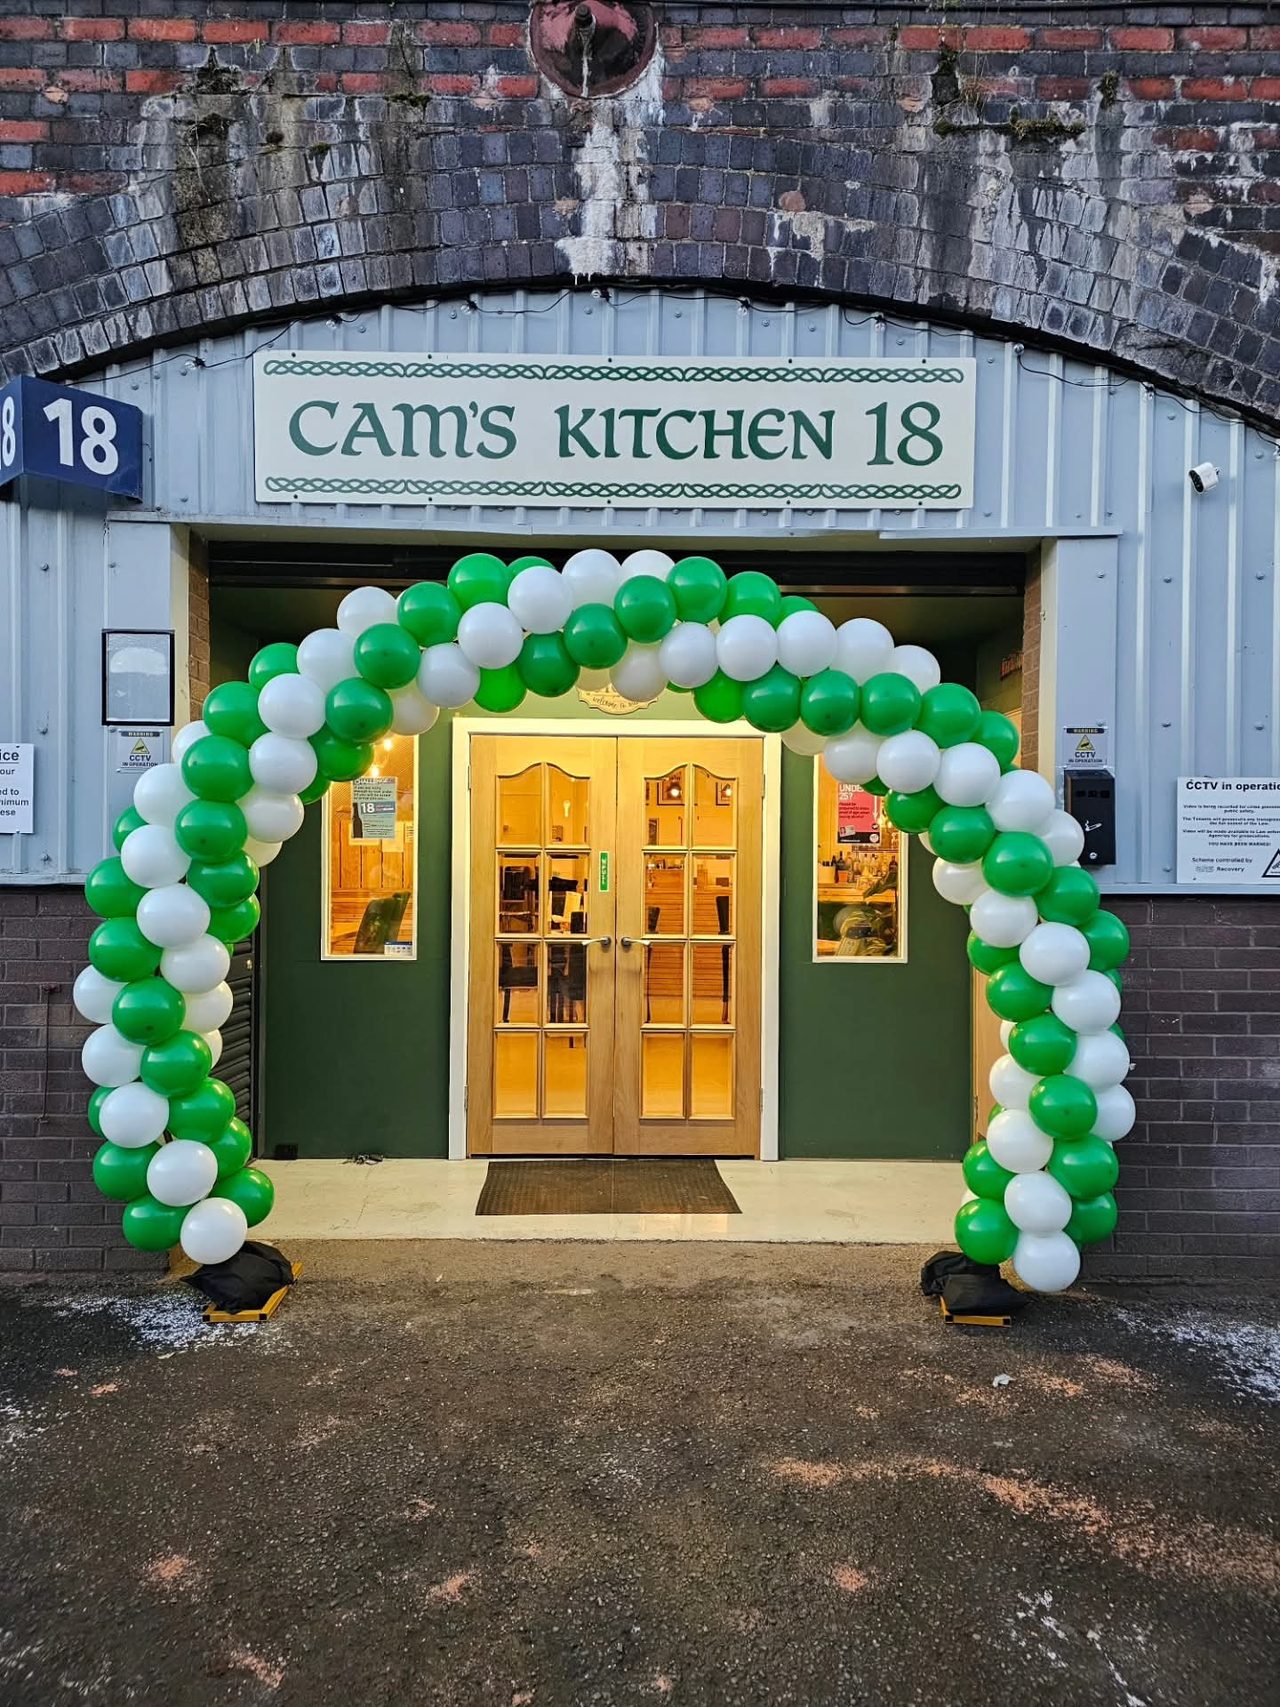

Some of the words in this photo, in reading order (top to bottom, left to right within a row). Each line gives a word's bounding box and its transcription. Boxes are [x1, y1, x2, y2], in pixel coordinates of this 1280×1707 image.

[0, 396, 16, 470] 8
[43, 398, 118, 475] 18
[289, 400, 517, 458] CAM'S
[556, 406, 835, 460] KITCHEN
[864, 401, 944, 466] 18
[360, 802, 375, 814] 18
[1186, 781, 1218, 790] CCTV
[1222, 782, 1232, 790] in
